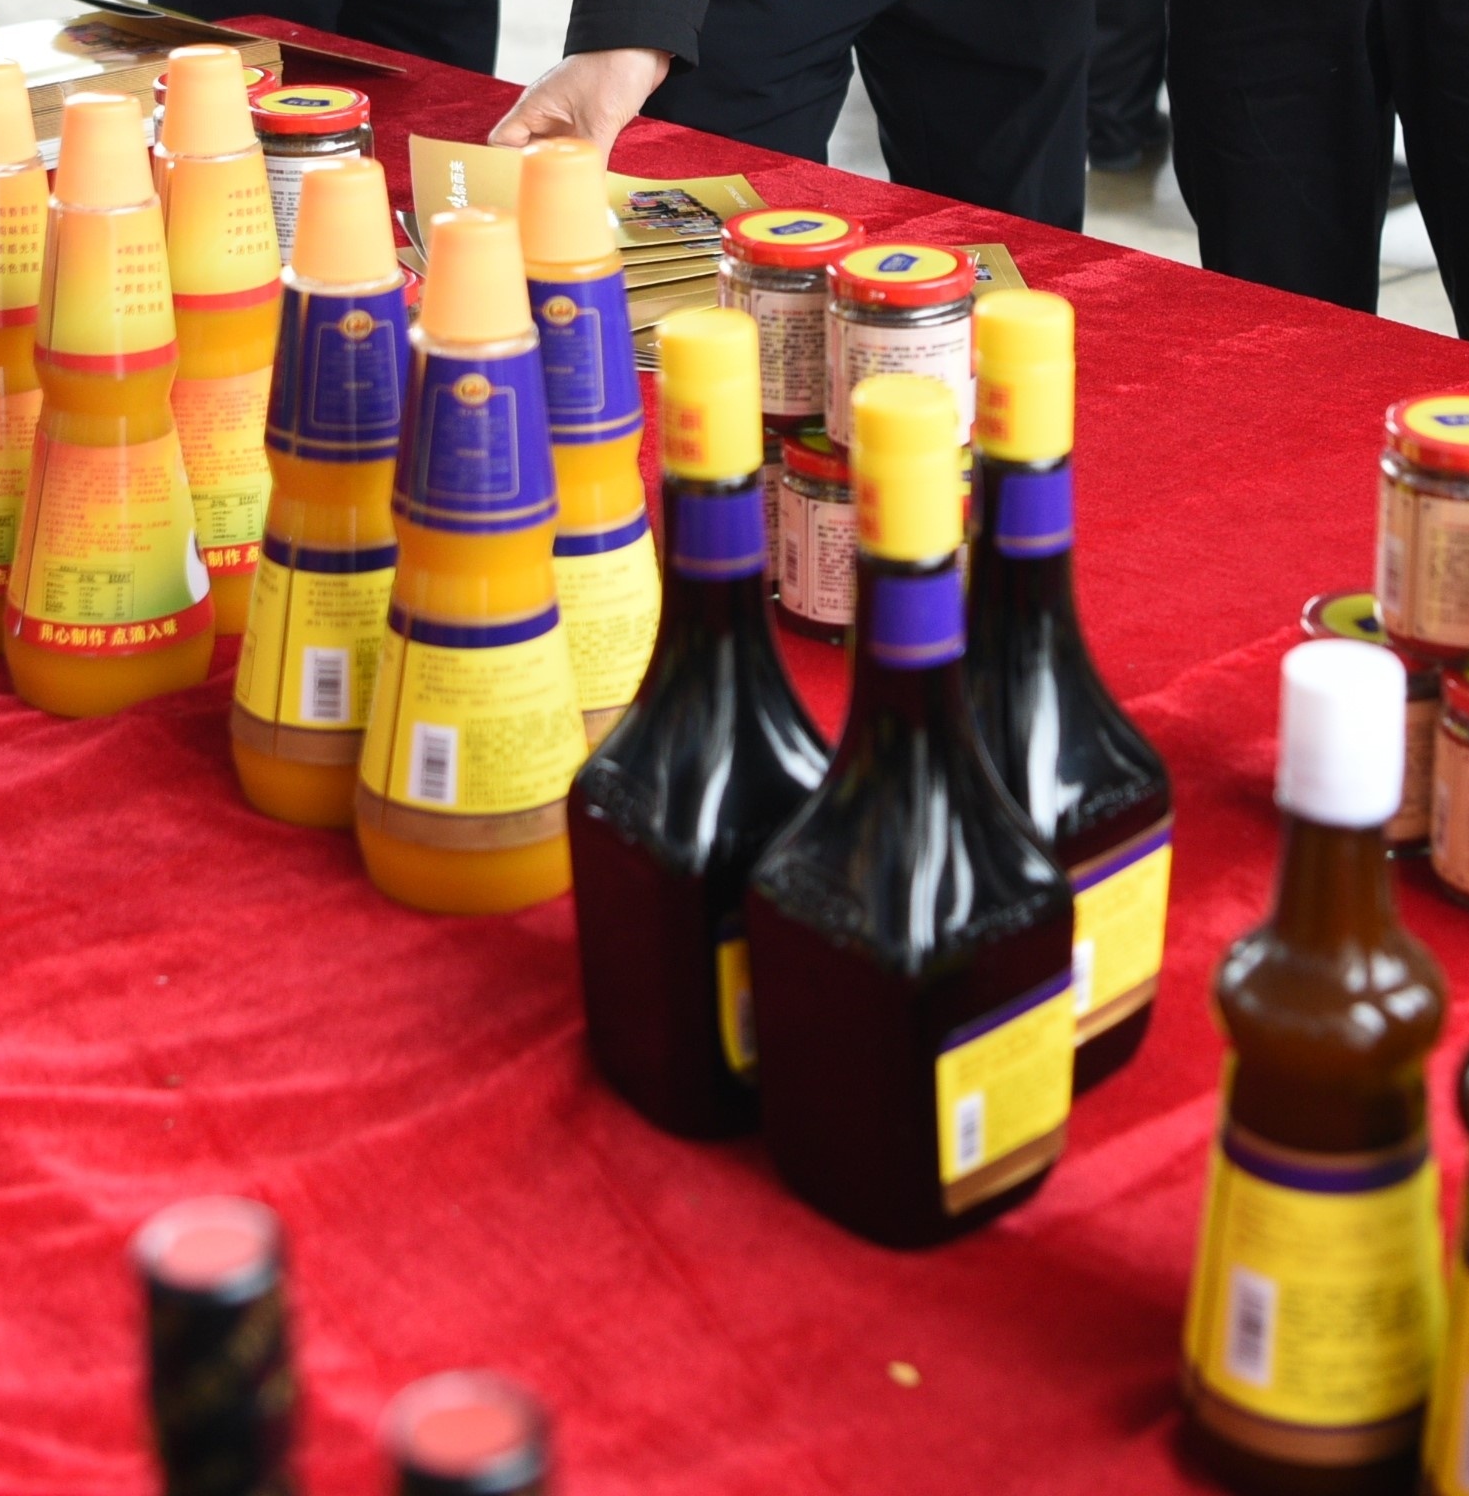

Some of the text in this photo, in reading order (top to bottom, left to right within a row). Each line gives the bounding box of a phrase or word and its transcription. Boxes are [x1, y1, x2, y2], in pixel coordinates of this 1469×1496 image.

[40, 618, 178, 647] 用心制作 点滴入味
